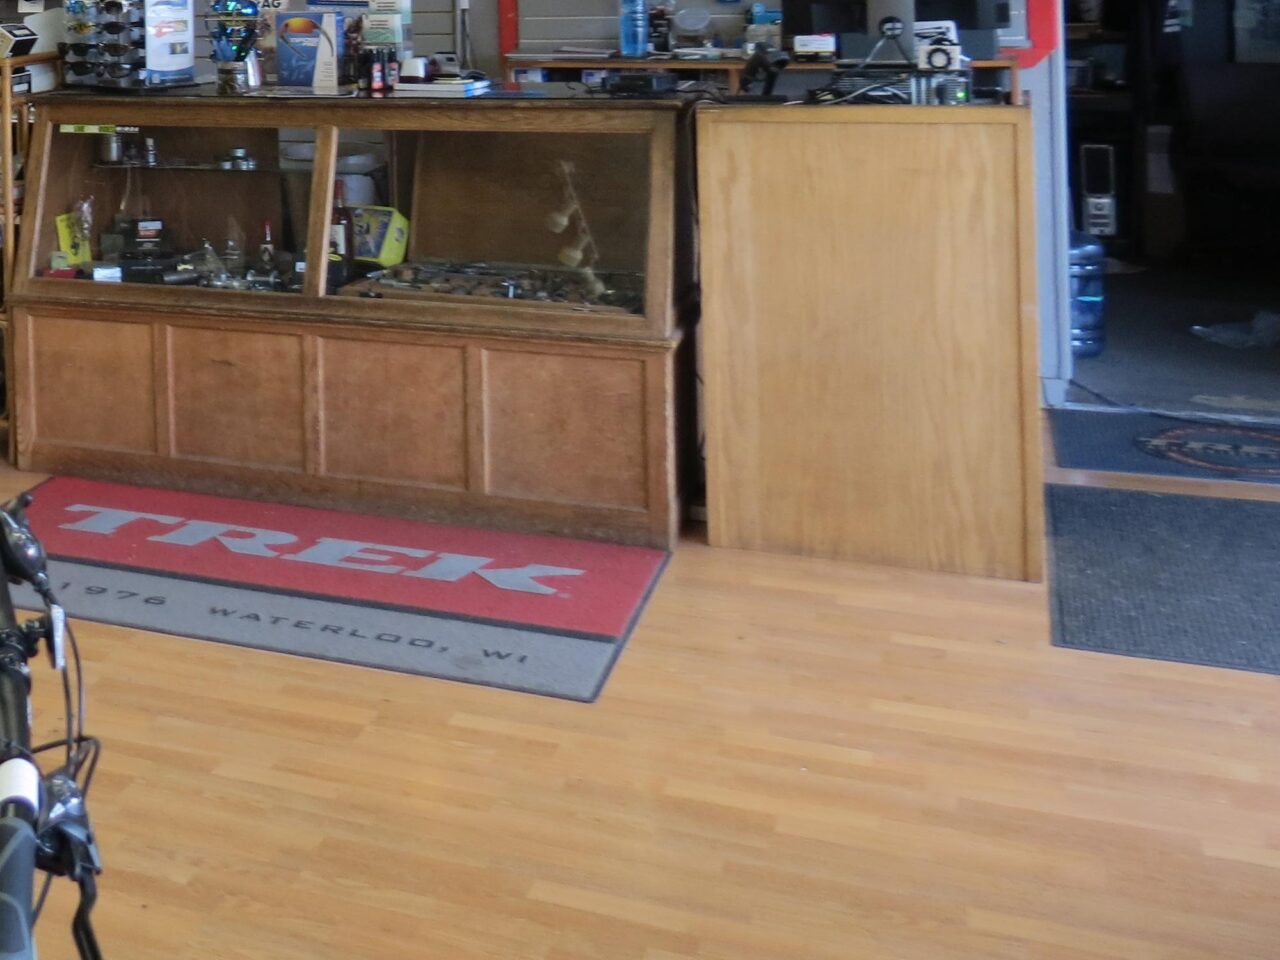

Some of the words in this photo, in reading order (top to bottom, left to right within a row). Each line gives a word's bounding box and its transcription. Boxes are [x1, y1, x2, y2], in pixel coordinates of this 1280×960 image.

[57, 502, 586, 596] TREK
[60, 581, 167, 607] 1976
[208, 605, 450, 655] WATERLOO,
[482, 646, 528, 665] WI
